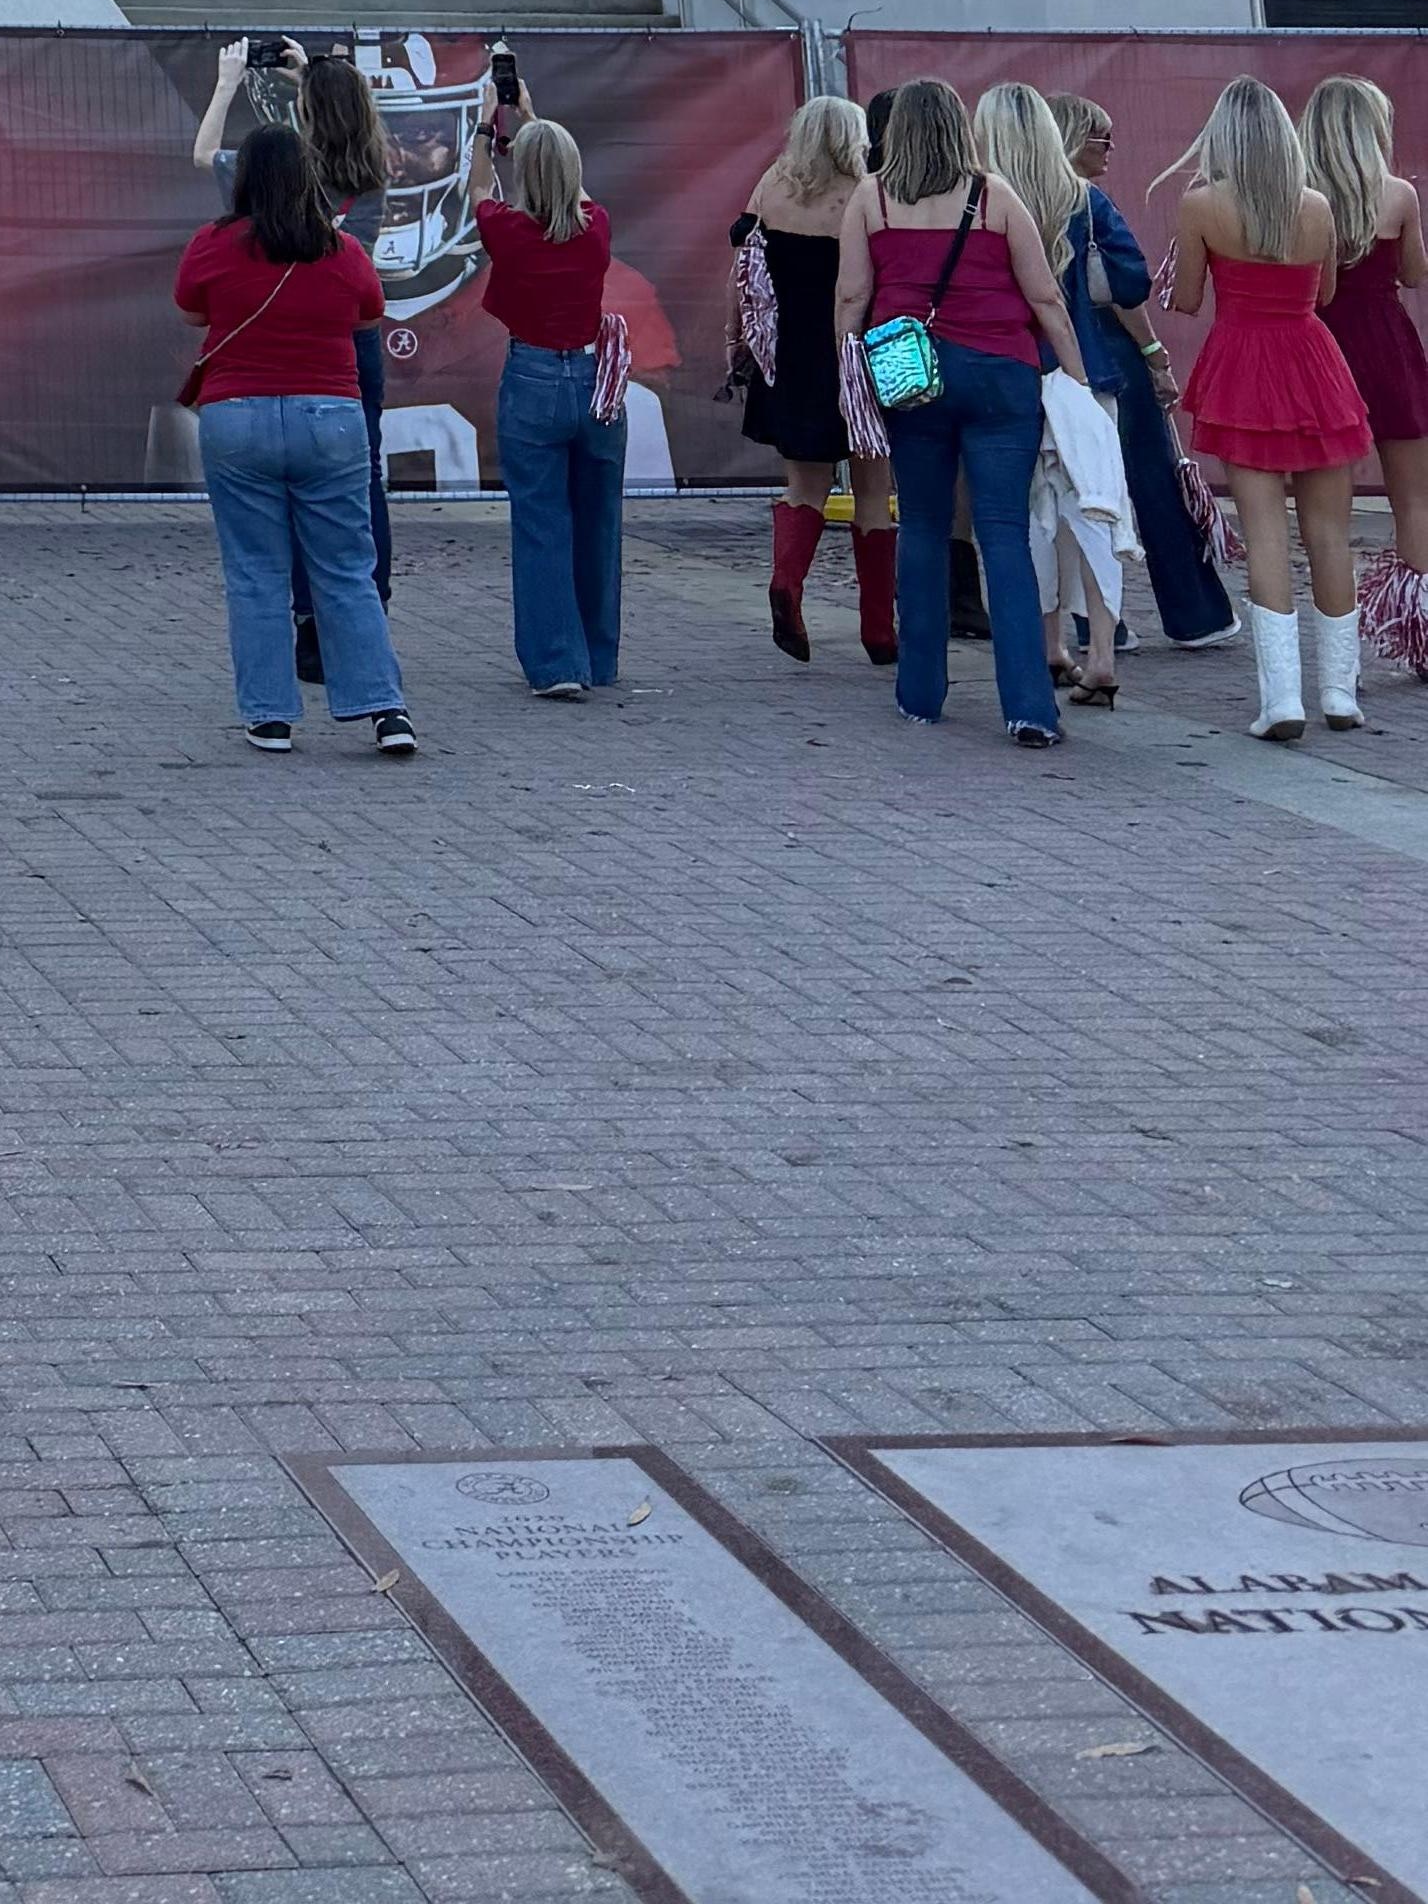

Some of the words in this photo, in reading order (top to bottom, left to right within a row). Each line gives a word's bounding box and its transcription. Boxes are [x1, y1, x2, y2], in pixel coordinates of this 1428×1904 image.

[454, 1522, 626, 1537] NATIONAL
[421, 1533, 685, 1550] CHAMPIONSHIP
[494, 1547, 639, 1561] PLAYERS
[1149, 1571, 1428, 1594] ALABAM
